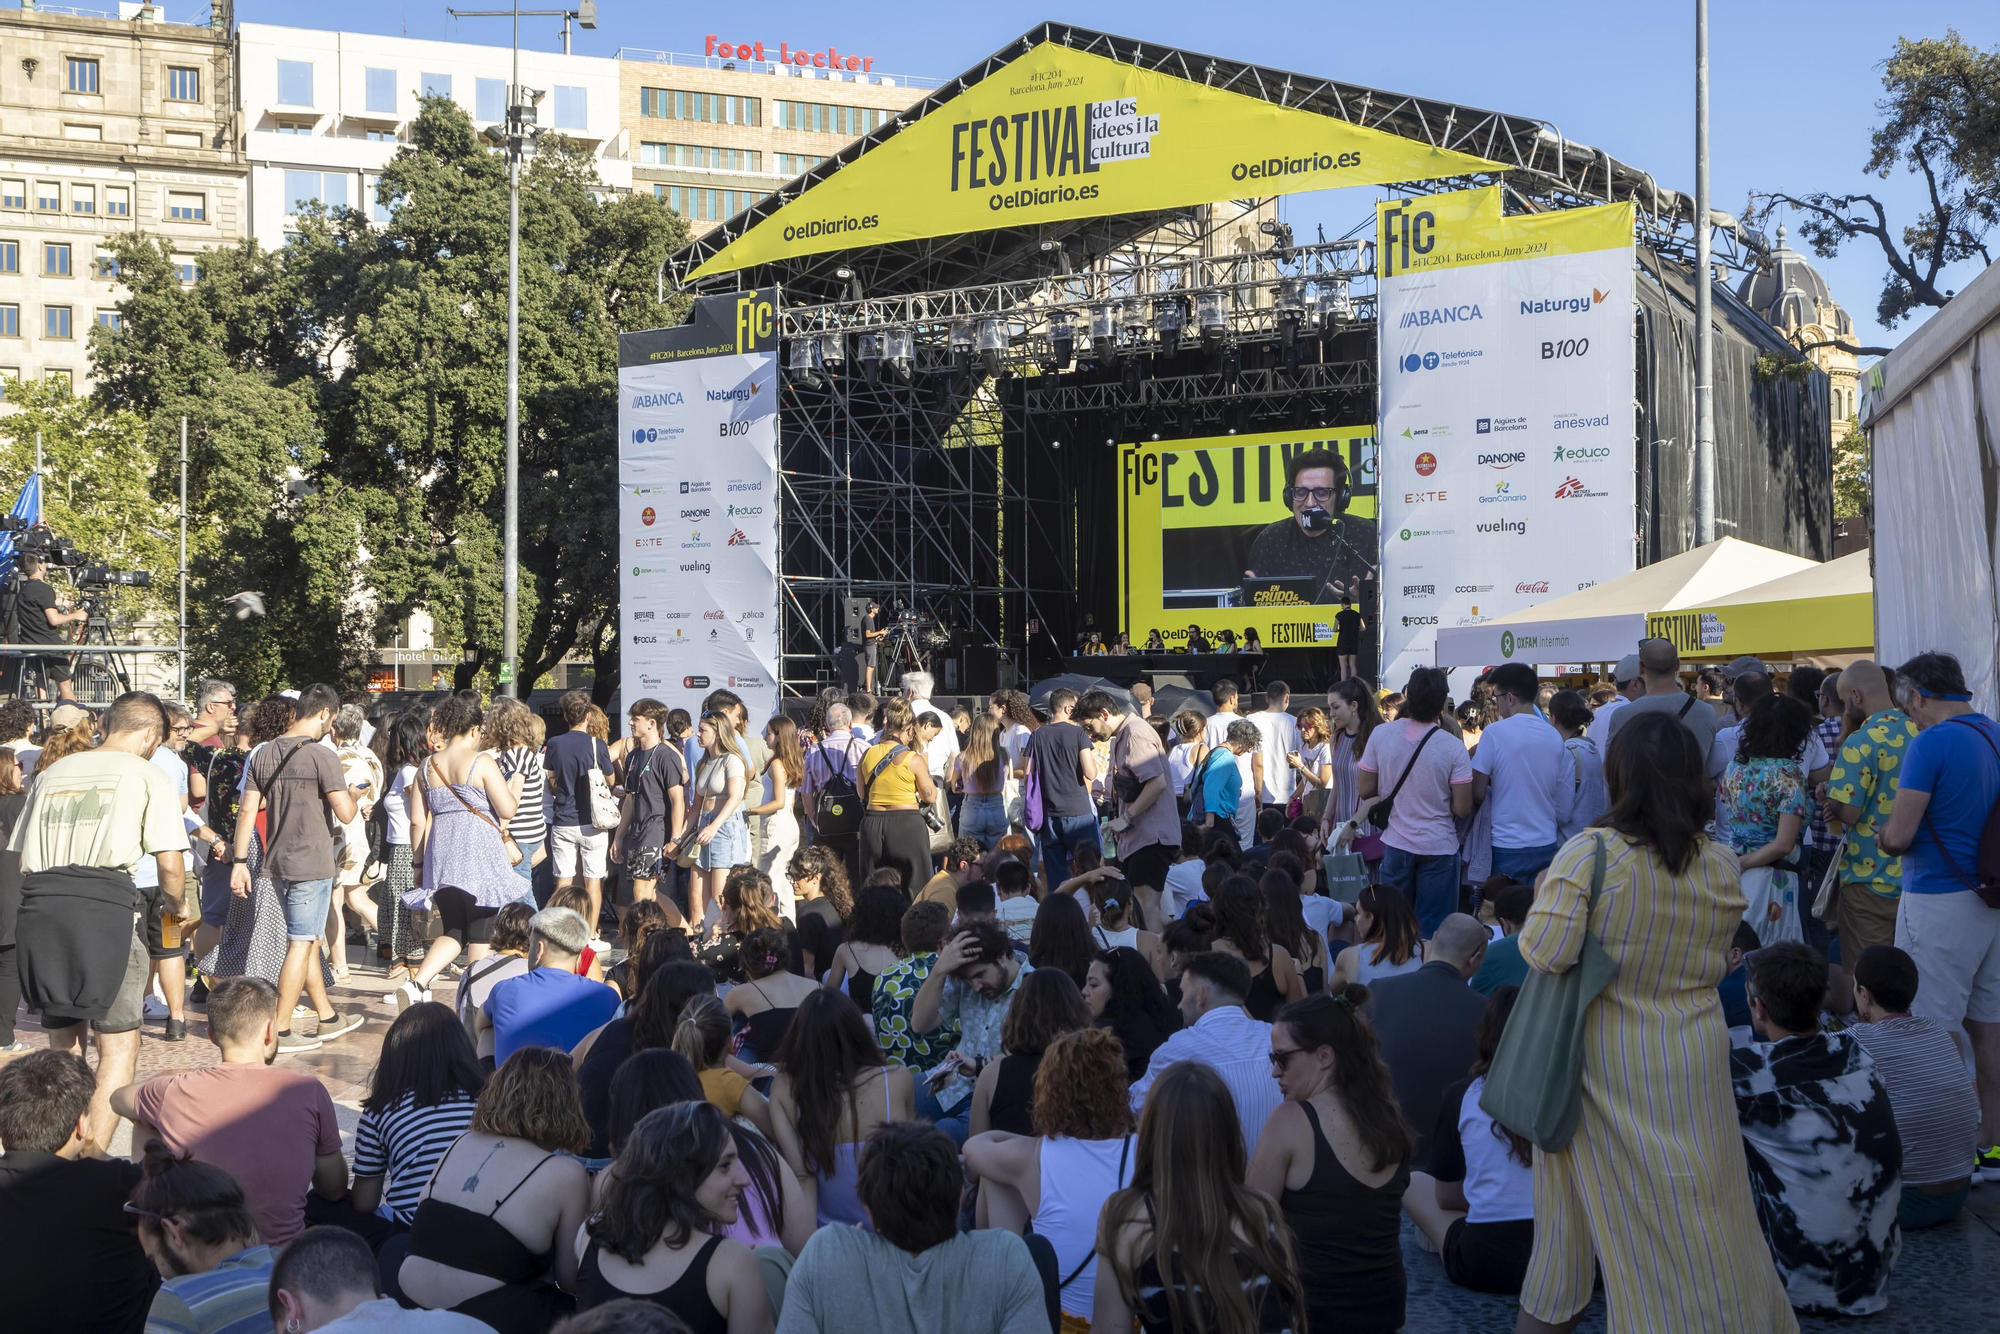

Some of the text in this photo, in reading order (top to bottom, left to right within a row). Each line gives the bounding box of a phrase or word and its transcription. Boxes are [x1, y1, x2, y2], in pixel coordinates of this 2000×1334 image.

[705, 34, 874, 72] Foot Locker
[1031, 70, 1062, 82] #FIC204
[1046, 80, 1063, 91] Juny
[1065, 76, 1084, 87] 2024
[1092, 100, 1137, 120] de les
[1091, 116, 1159, 140] idees i la
[951, 103, 1100, 192] FESTIVAL
[1091, 139, 1150, 160] cultura
[1413, 254, 1450, 268] #FIC204
[1502, 245, 1523, 257] Juny
[1524, 242, 1548, 254] 2024
[1520, 296, 1590, 314] Naturgy
[1441, 348, 1483, 360] Telefónica
[1541, 338, 1589, 360] B100
[707, 388, 750, 402] Naturgy
[1494, 417, 1516, 426] Aigües
[1494, 423, 1527, 432] Barcelona
[1554, 414, 1609, 430] anesvad
[720, 421, 749, 437] B100
[1566, 447, 1610, 459] educo
[727, 480, 762, 492] anesvad
[1405, 491, 1447, 503] EXTE
[735, 506, 763, 516] educo
[1476, 517, 1526, 535] vueling
[635, 538, 663, 548] EXTE
[680, 560, 711, 574] vueling
[1403, 585, 1435, 596] BEEFEATER
[1455, 585, 1477, 593] CCCB
[634, 611, 655, 621] BEEFEATER
[1408, 616, 1439, 626] FOCUS
[1709, 614, 1717, 622] les
[1272, 623, 1318, 643] FESTIVAL
[1702, 624, 1716, 633] idees
[638, 636, 657, 644] FOCUS
[1517, 633, 1570, 649] OXFAM Intermón
[1702, 635, 1723, 644] cultura
[398, 651, 425, 661] hotel
